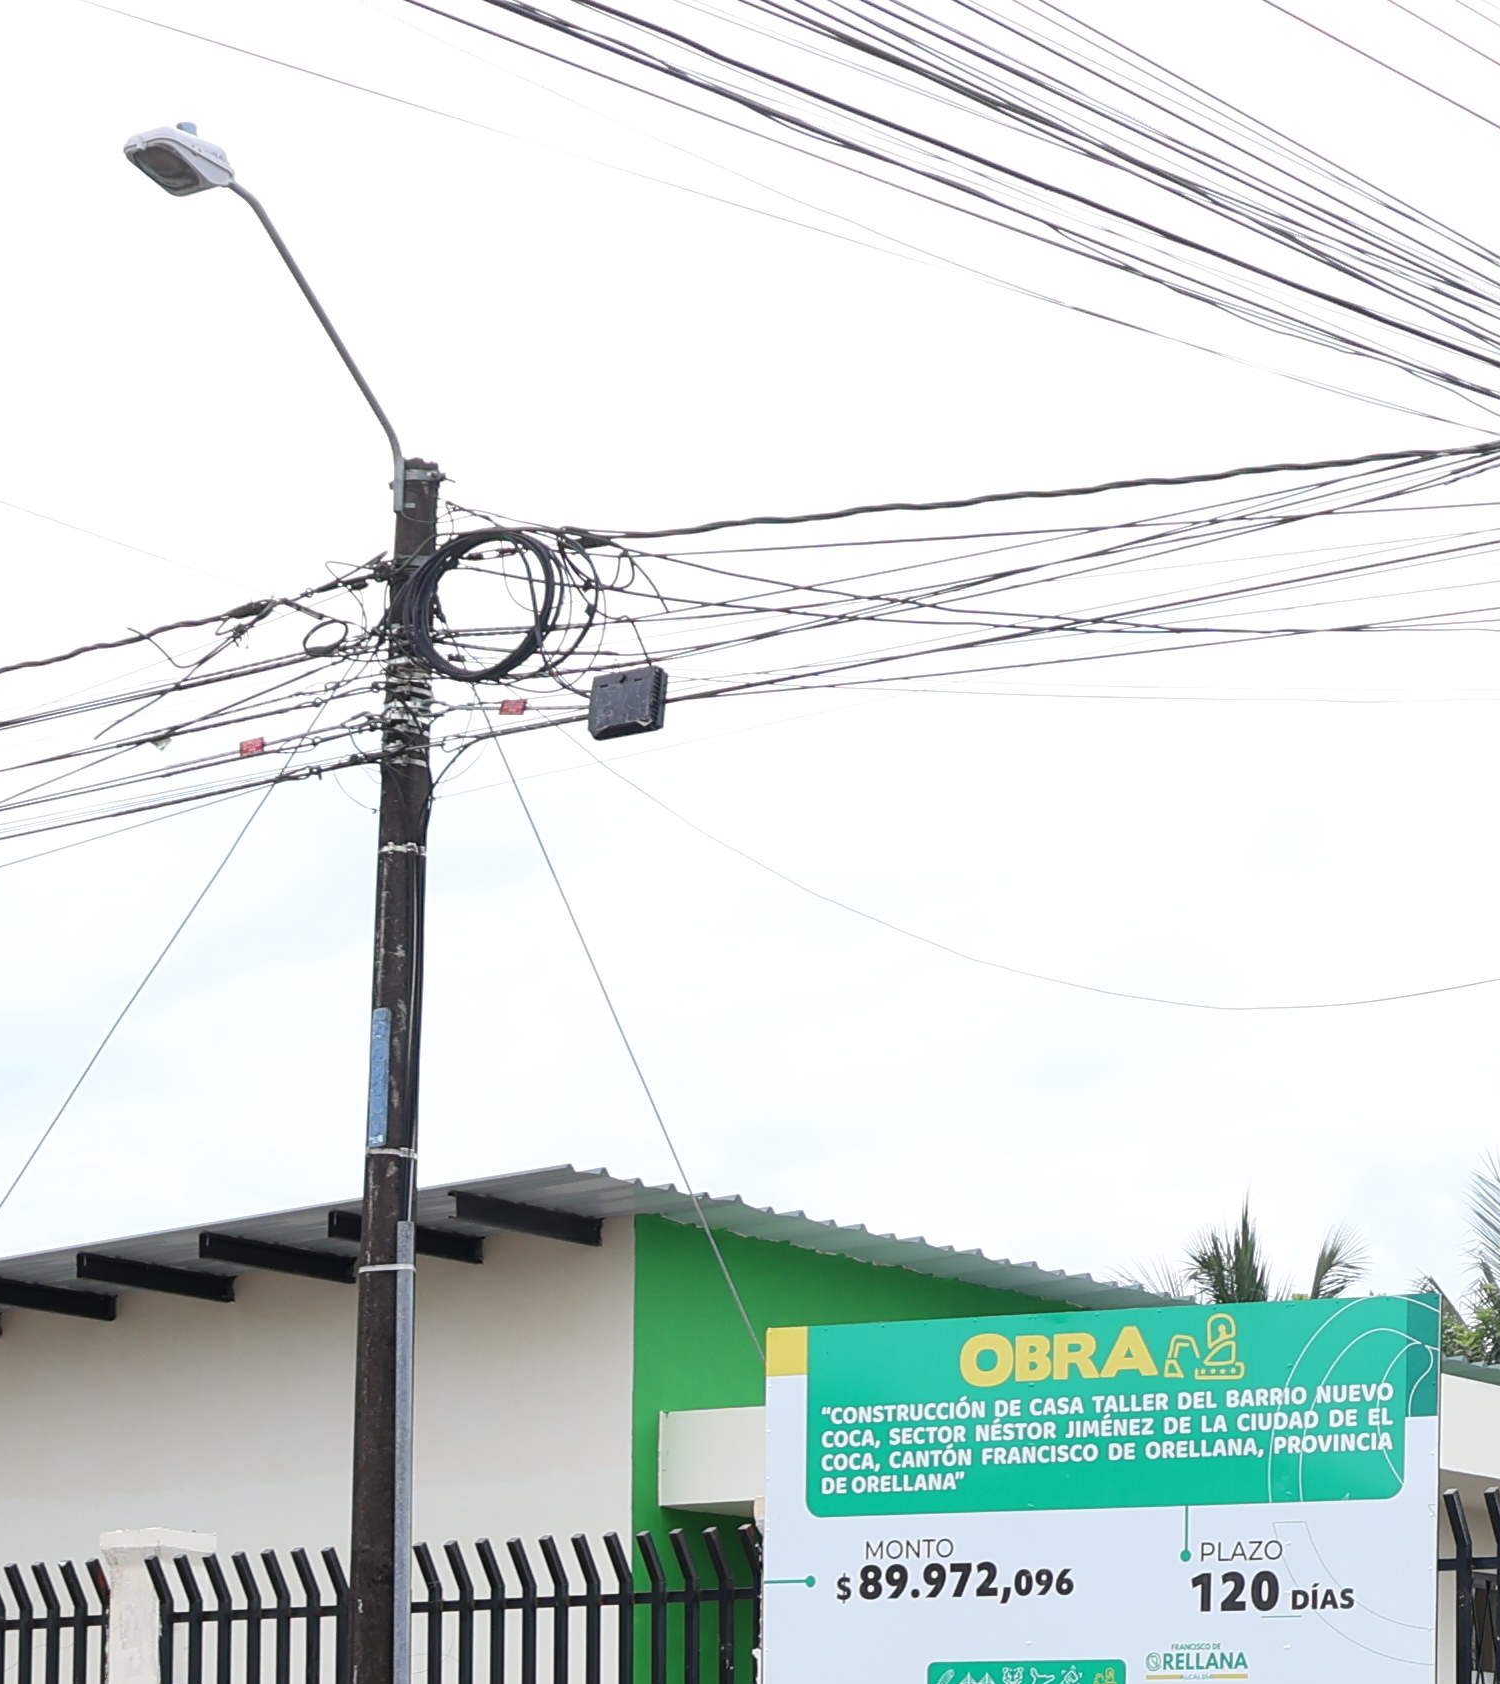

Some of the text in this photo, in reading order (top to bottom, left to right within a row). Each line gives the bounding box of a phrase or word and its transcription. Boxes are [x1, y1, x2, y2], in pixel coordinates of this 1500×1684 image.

[960, 1325, 1158, 1387] OBRA
[821, 1382, 1394, 1425] “CONSTRUCCIÓN DE CASA TALLER DEL BARRIO NUEVO
[821, 1406, 1394, 1449] COCA, SECTOR NÉSTOR JIMÉNEZ DE LA CIUDAD DE EL
[821, 1432, 1394, 1472] COCA, CANTÓN FRANCISCO DE ORELLANA, PROVINCIA
[821, 1470, 966, 1495] DE ORELLANA”
[865, 1538, 955, 1561] MONTO
[1200, 1539, 1284, 1562] PLAZO
[1190, 1570, 1355, 1613] 120 DÍAS
[1145, 1651, 1249, 1672] ORELLANA
[1171, 1642, 1222, 1651] FRANCISCO DE
